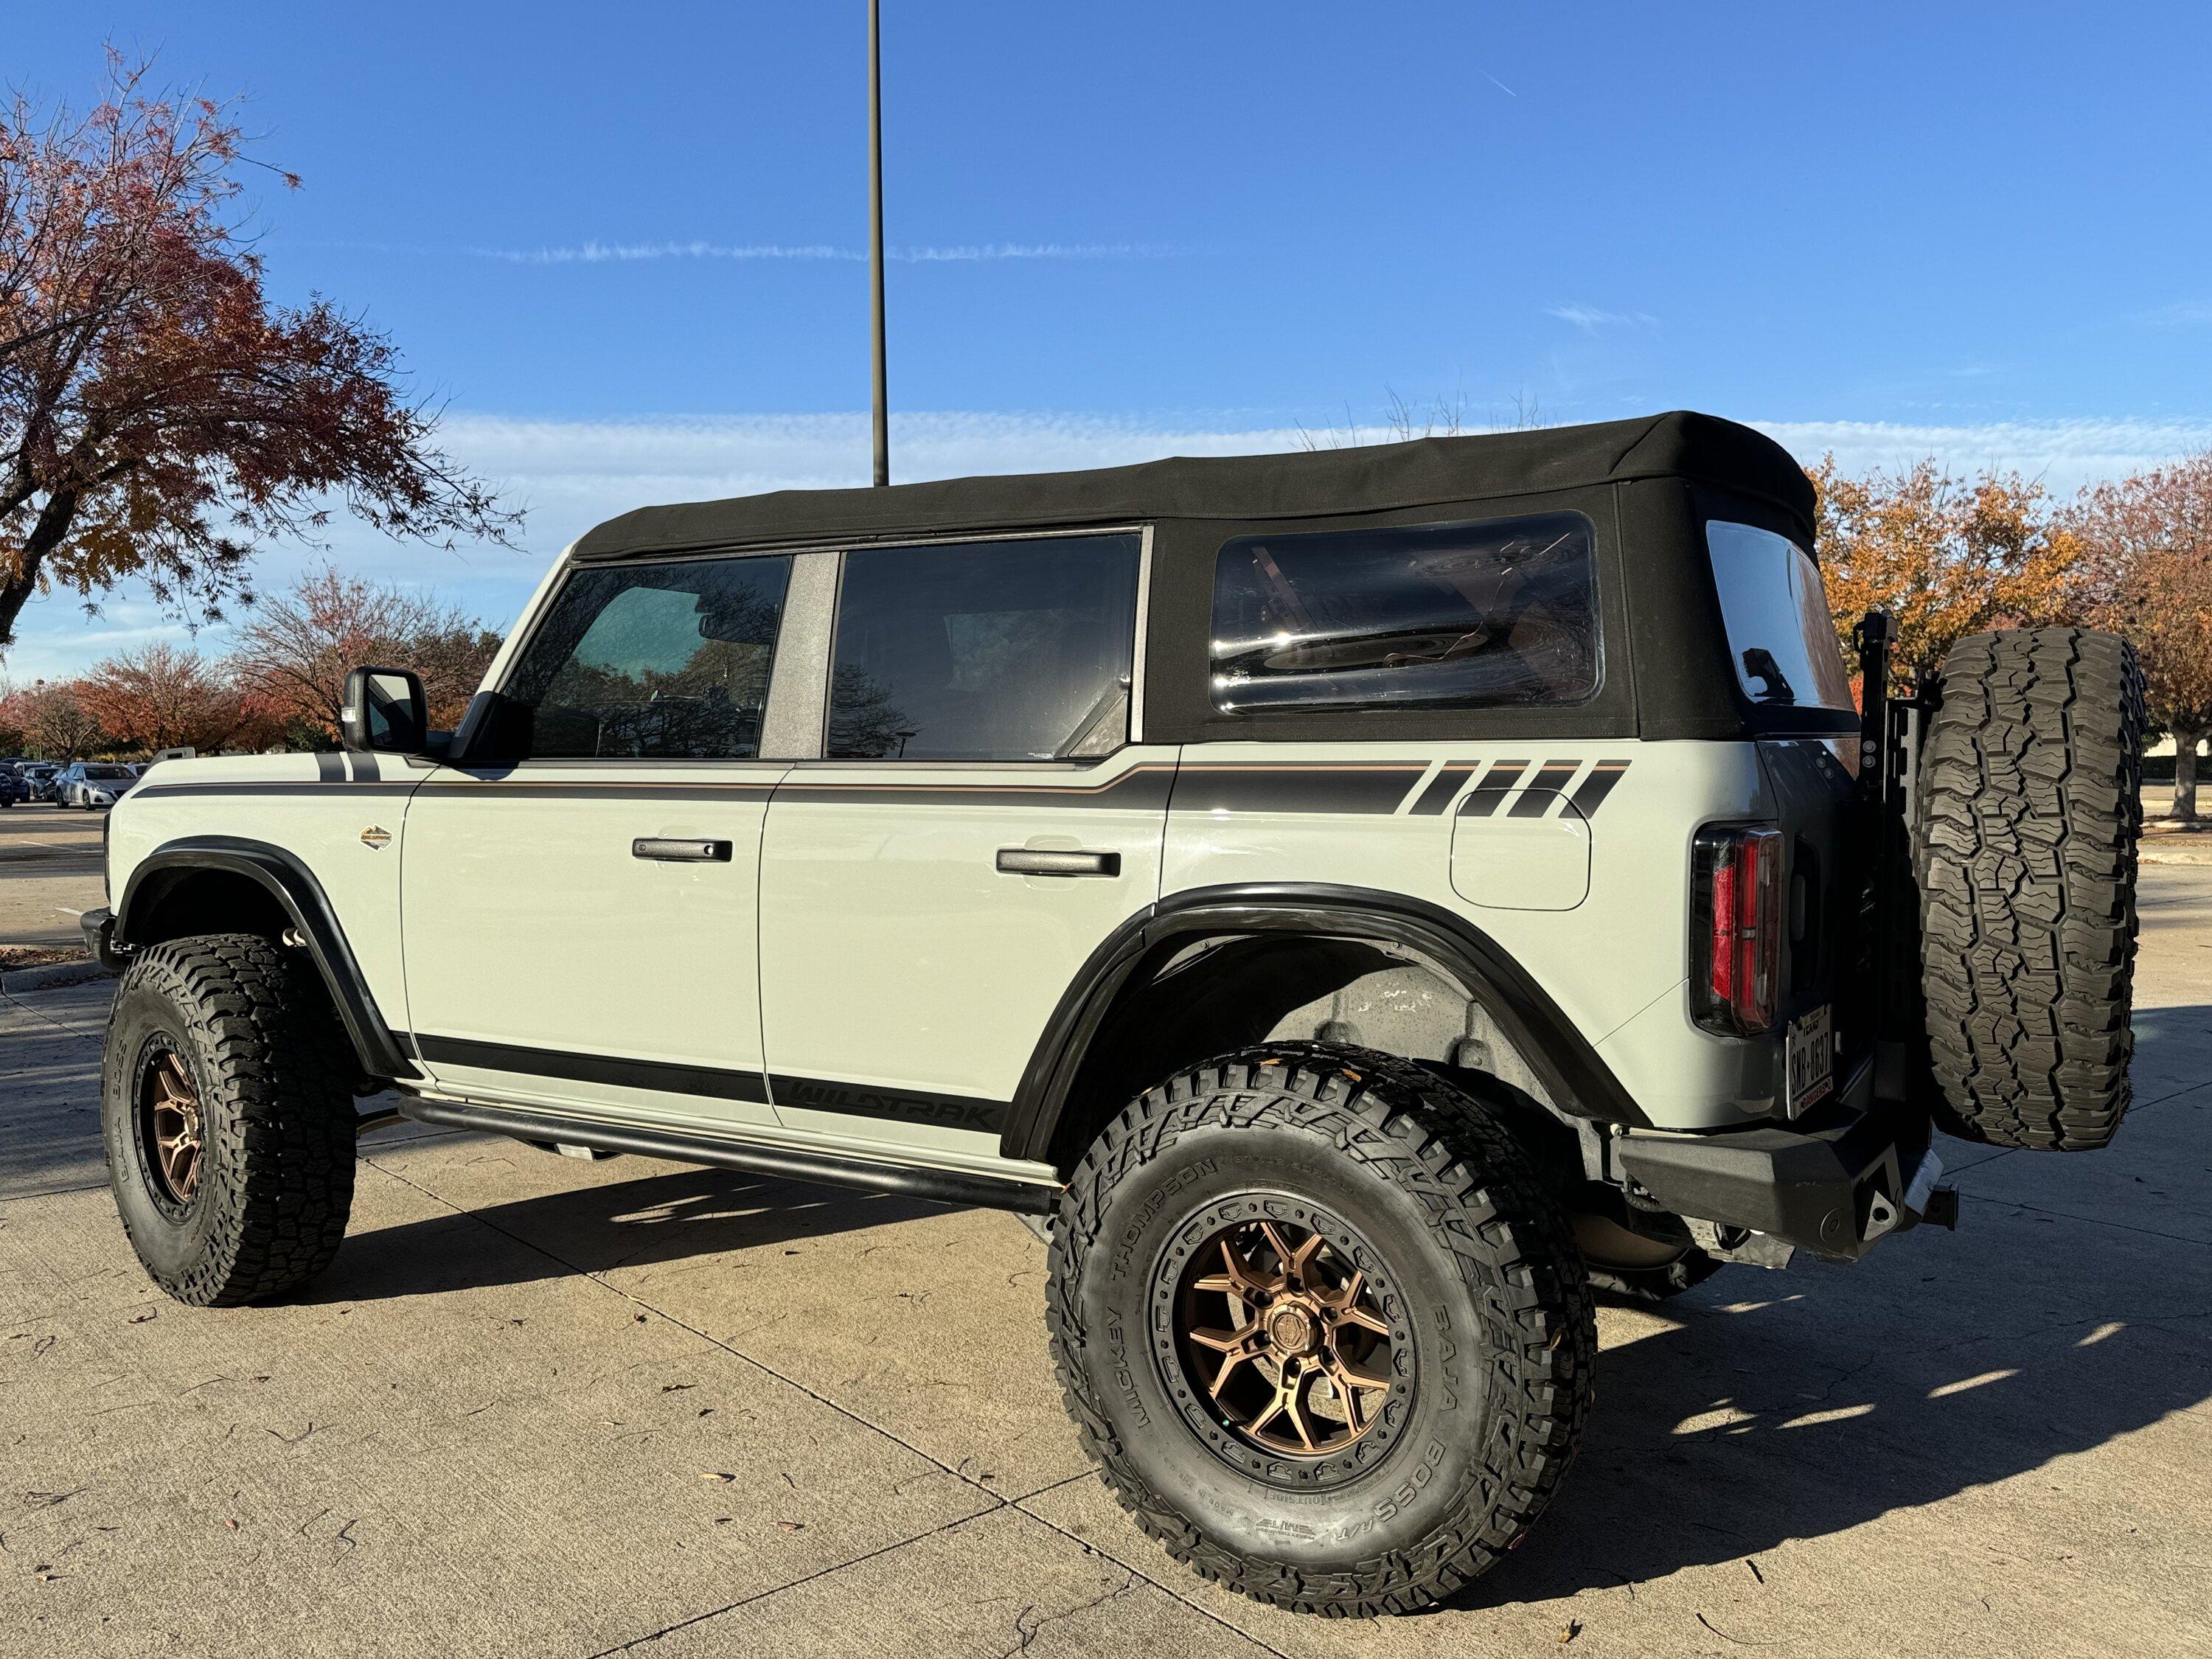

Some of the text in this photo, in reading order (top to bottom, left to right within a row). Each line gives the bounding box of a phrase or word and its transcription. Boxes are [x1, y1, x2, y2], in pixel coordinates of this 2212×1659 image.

[113, 1038, 128, 1099] BOSS
[789, 1082, 997, 1130] WILDTRAK
[1112, 1158, 1219, 1281] THOMPSON
[1107, 1306, 1151, 1429] MICKEY
[1433, 1304, 1458, 1412] BAJA
[1374, 1437, 1447, 1522] BOSS
